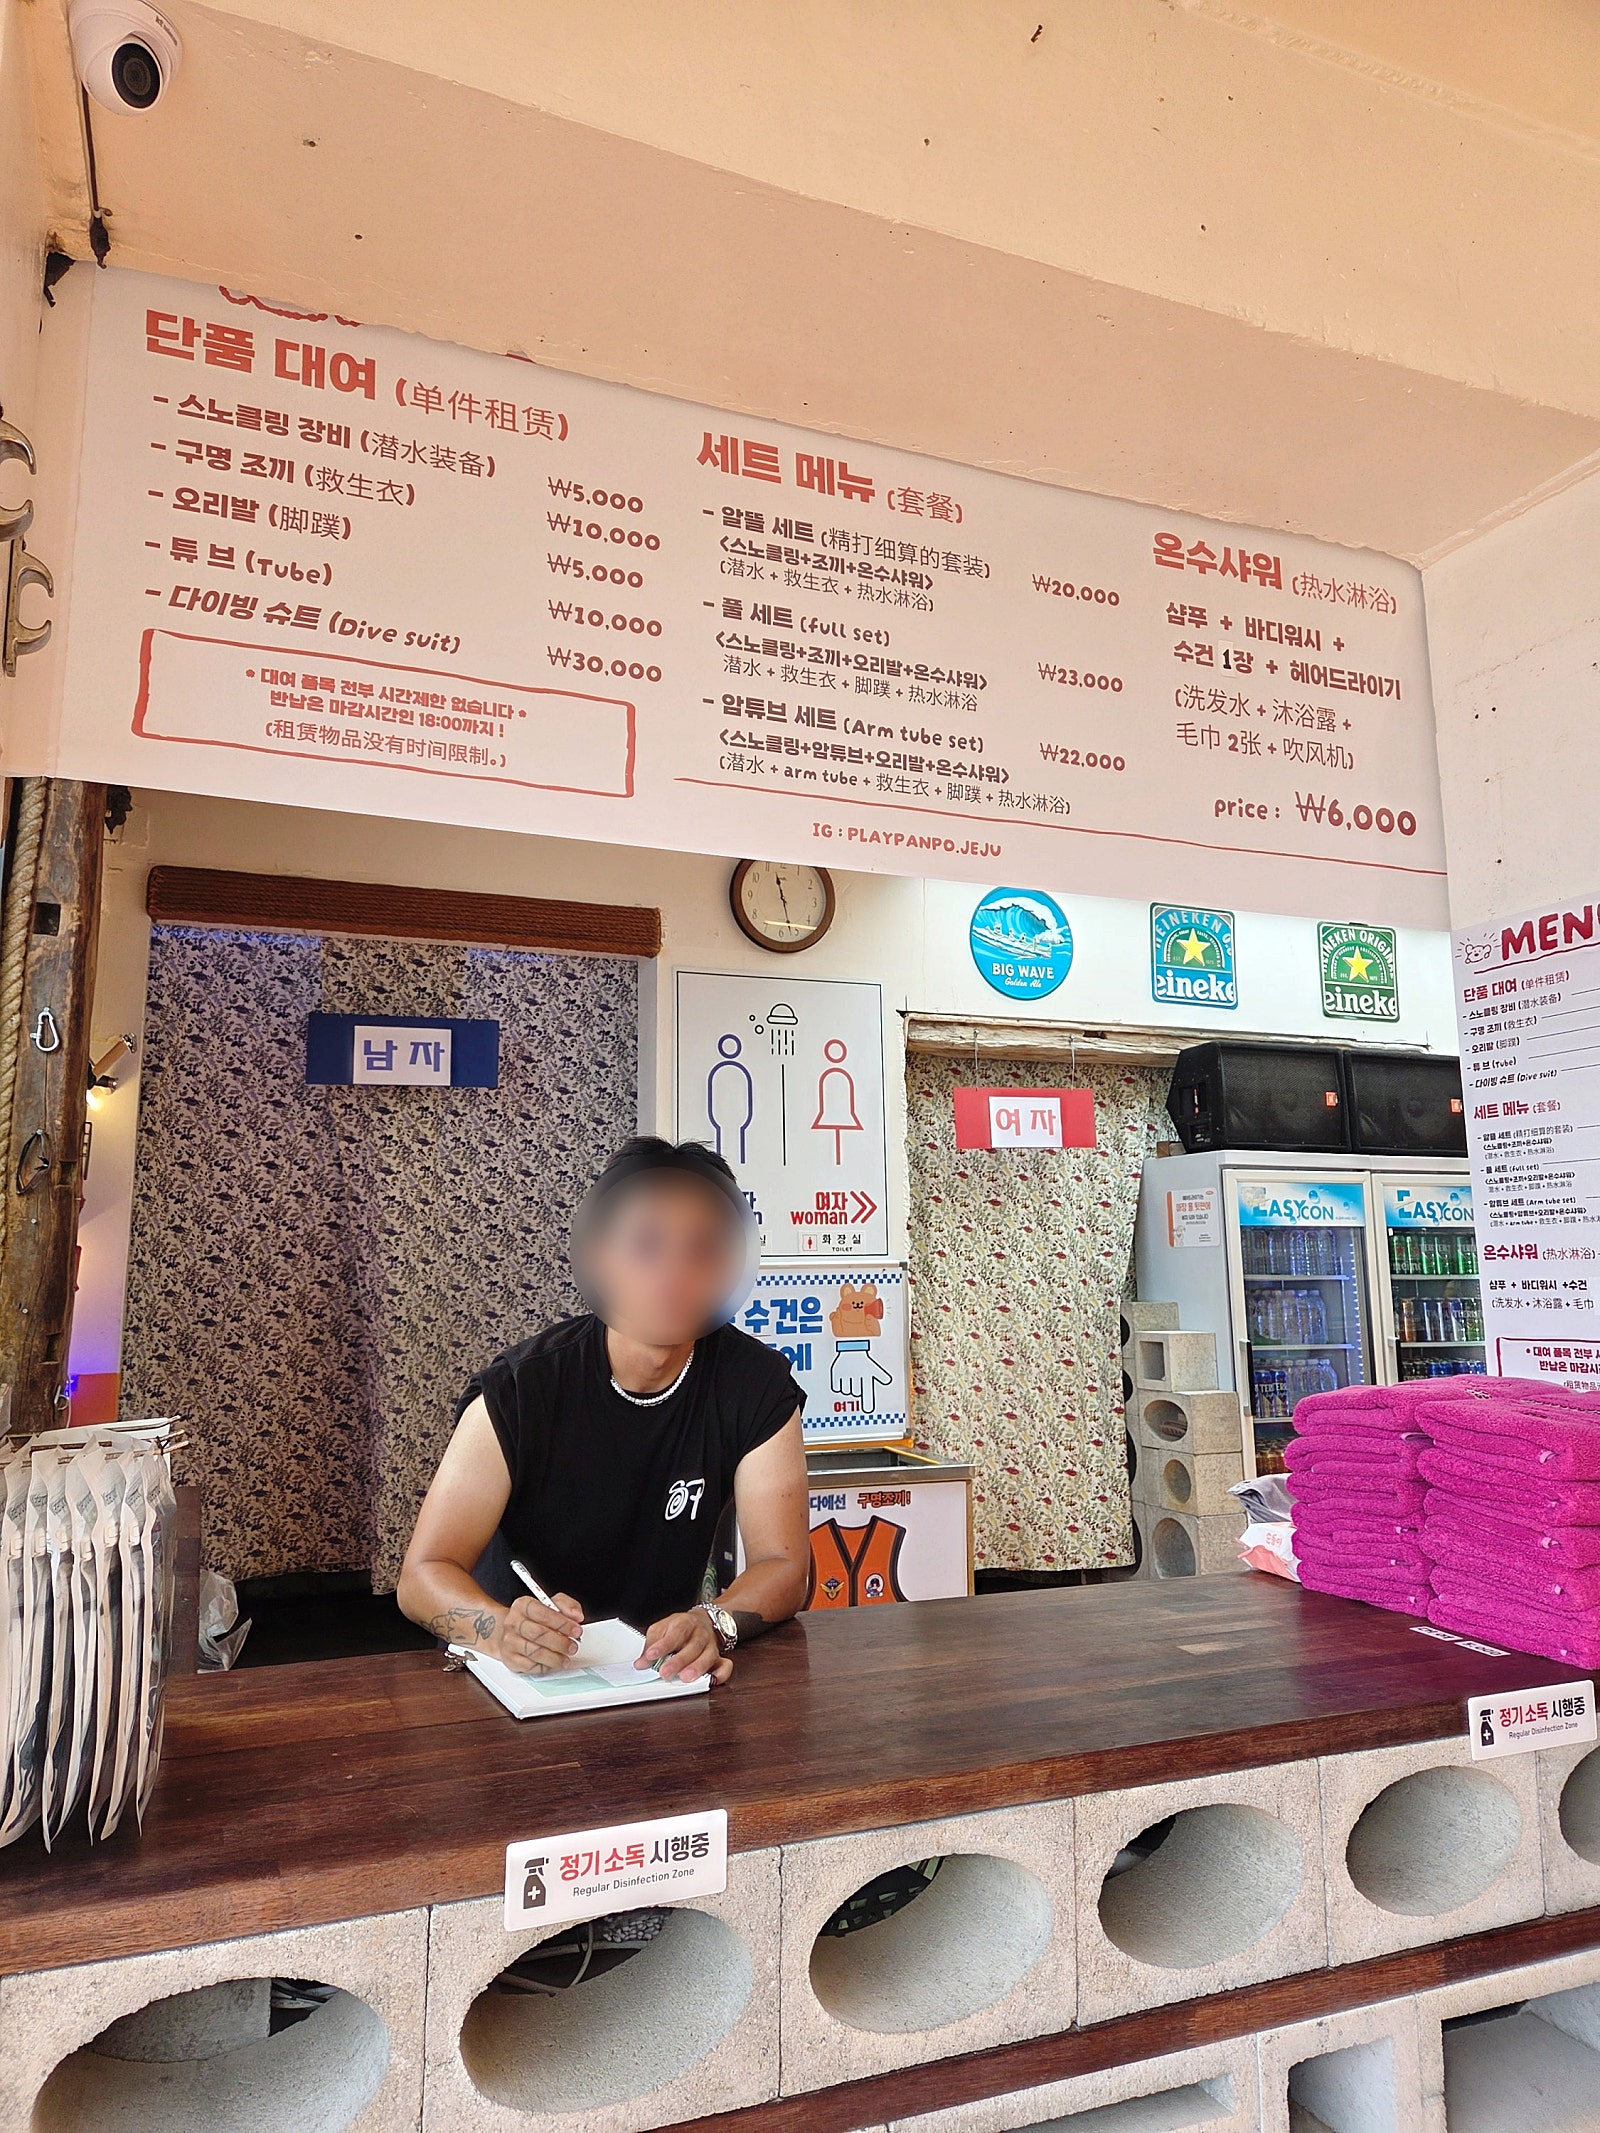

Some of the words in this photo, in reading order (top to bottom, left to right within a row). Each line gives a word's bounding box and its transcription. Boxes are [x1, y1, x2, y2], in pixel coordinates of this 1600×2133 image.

[145, 308, 255, 374] 단품
[274, 337, 376, 400] 대여
[395, 377, 569, 442] (单件租赁)
[177, 393, 289, 437] 스노클링
[297, 417, 351, 449] 장비
[359, 430, 496, 478] (潜水装备)
[175, 438, 232, 471] 구명
[240, 453, 295, 483] 조끼
[305, 462, 416, 506] (救生衣)
[697, 431, 782, 485] 세트
[795, 452, 876, 504] 메뉴
[887, 486, 964, 524] (套餐)
[172, 486, 260, 524] 오리발
[721, 505, 765, 534] 알뜰
[772, 516, 815, 544] 세트
[821, 527, 991, 579] (精打细算的套装)
[245, 549, 333, 587] (Tube)
[1153, 532, 1283, 590] 온수샤워
[1292, 571, 1397, 615] (热水淋浴)
[168, 584, 260, 621] 다이빙
[262, 600, 322, 631] 슈트
[328, 609, 397, 646] (Dive
[403, 629, 462, 655] suit)
[721, 597, 743, 621] 풀
[750, 601, 794, 629] 세트
[799, 616, 849, 641] (full
[853, 625, 891, 647] set)
[1166, 601, 1208, 628] 샴푸
[1245, 616, 1322, 652] 바디워시
[1173, 640, 1215, 668] 수건
[1290, 660, 1401, 700] 헤어드라이기
[260, 667, 296, 689] 대여
[339, 678, 375, 700] 전부
[378, 684, 447, 709] 시간제한
[450, 694, 515, 720] 없습니다
[269, 689, 324, 714] 반납은
[329, 698, 415, 727] 마감시간인
[721, 693, 788, 723] 암튜브
[794, 705, 837, 731] 세트
[843, 716, 894, 739] (Arm
[900, 724, 943, 748] tube
[948, 733, 985, 754] set)
[783, 765, 817, 781] arm
[822, 767, 858, 788] tube
[811, 821, 833, 839] IG
[847, 826, 1003, 858] PLAYPANPO.JEJU
[1501, 903, 1600, 961] MEN
[992, 962, 1014, 977] BIG
[1018, 965, 1054, 979] WAVE
[1463, 985, 1489, 1003] 단품
[1492, 978, 1518, 996] 대여
[1500, 1002, 1516, 1013] 장비
[1473, 1103, 1499, 1120] 세트
[1502, 1100, 1529, 1116] 메뉴
[790, 1211, 848, 1225] woman
[815, 1191, 848, 1211] 여자
[1483, 1243, 1538, 1260] 온수샤워
[1489, 1280, 1506, 1290] 샴푸
[1521, 1279, 1557, 1290] 바디워시
[744, 1296, 823, 1334] 수건은
[834, 1401, 860, 1413] 여기
[857, 1490, 911, 1509] 구명조끼!
[1551, 1696, 1585, 1718] 시행중
[1509, 1730, 1530, 1739] Regular
[1532, 1724, 1563, 1735] Disinfection
[1565, 1721, 1578, 1729] Zone
[650, 1832, 710, 1864] 시행중
[573, 1883, 610, 1897] Regular
[613, 1873, 669, 1889] Disinfection
[672, 1867, 695, 1879] Zone
